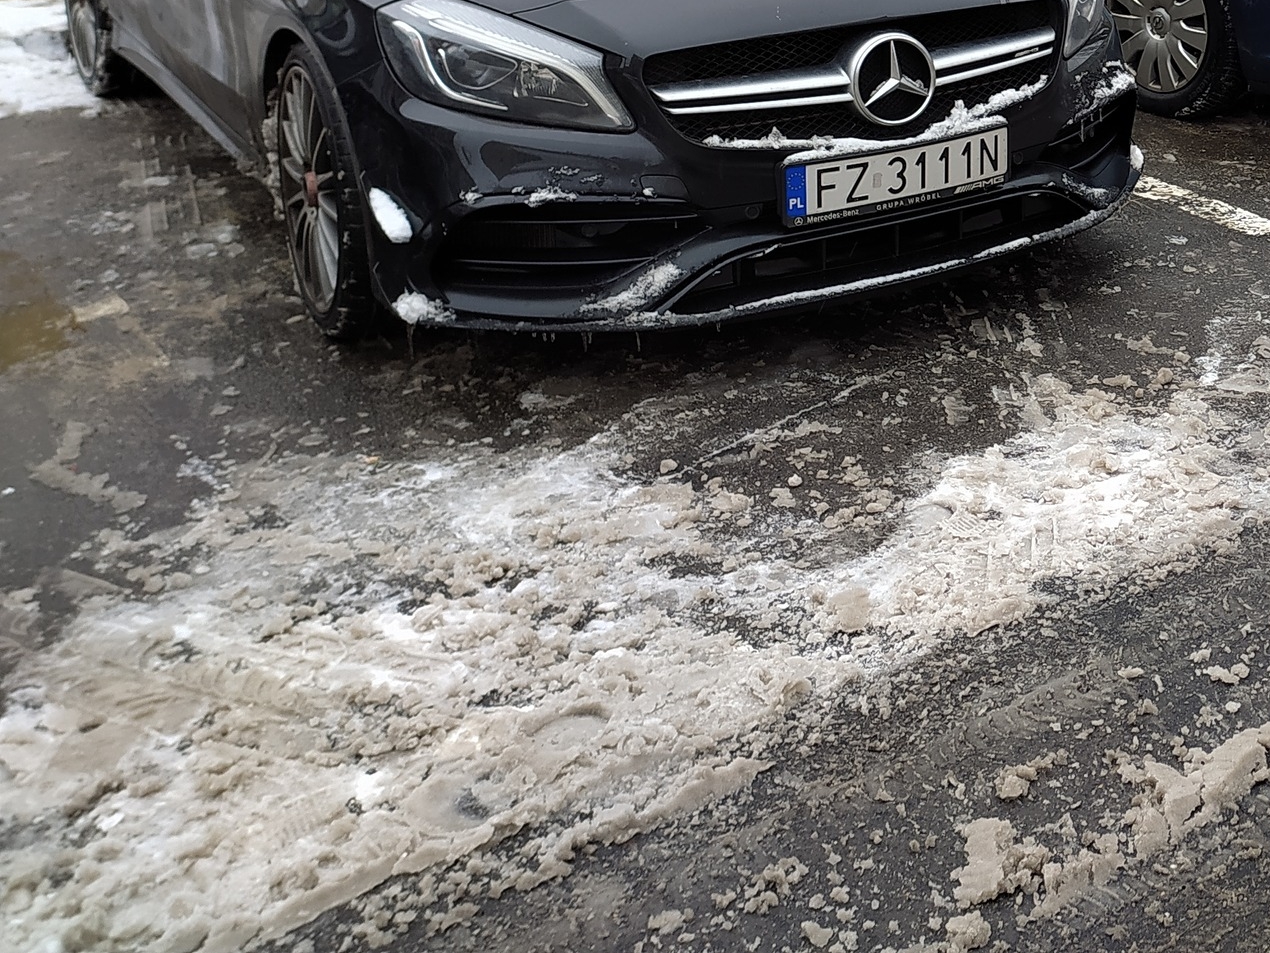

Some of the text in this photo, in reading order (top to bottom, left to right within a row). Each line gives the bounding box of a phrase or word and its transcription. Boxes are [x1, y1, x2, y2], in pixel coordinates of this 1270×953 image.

[816, 133, 998, 209] FZ 3111N
[972, 175, 1005, 190] AMG
[789, 198, 804, 210] PL
[876, 192, 942, 212] GRUPA WRÓBEL
[806, 208, 860, 224] Mercedes-Benz
